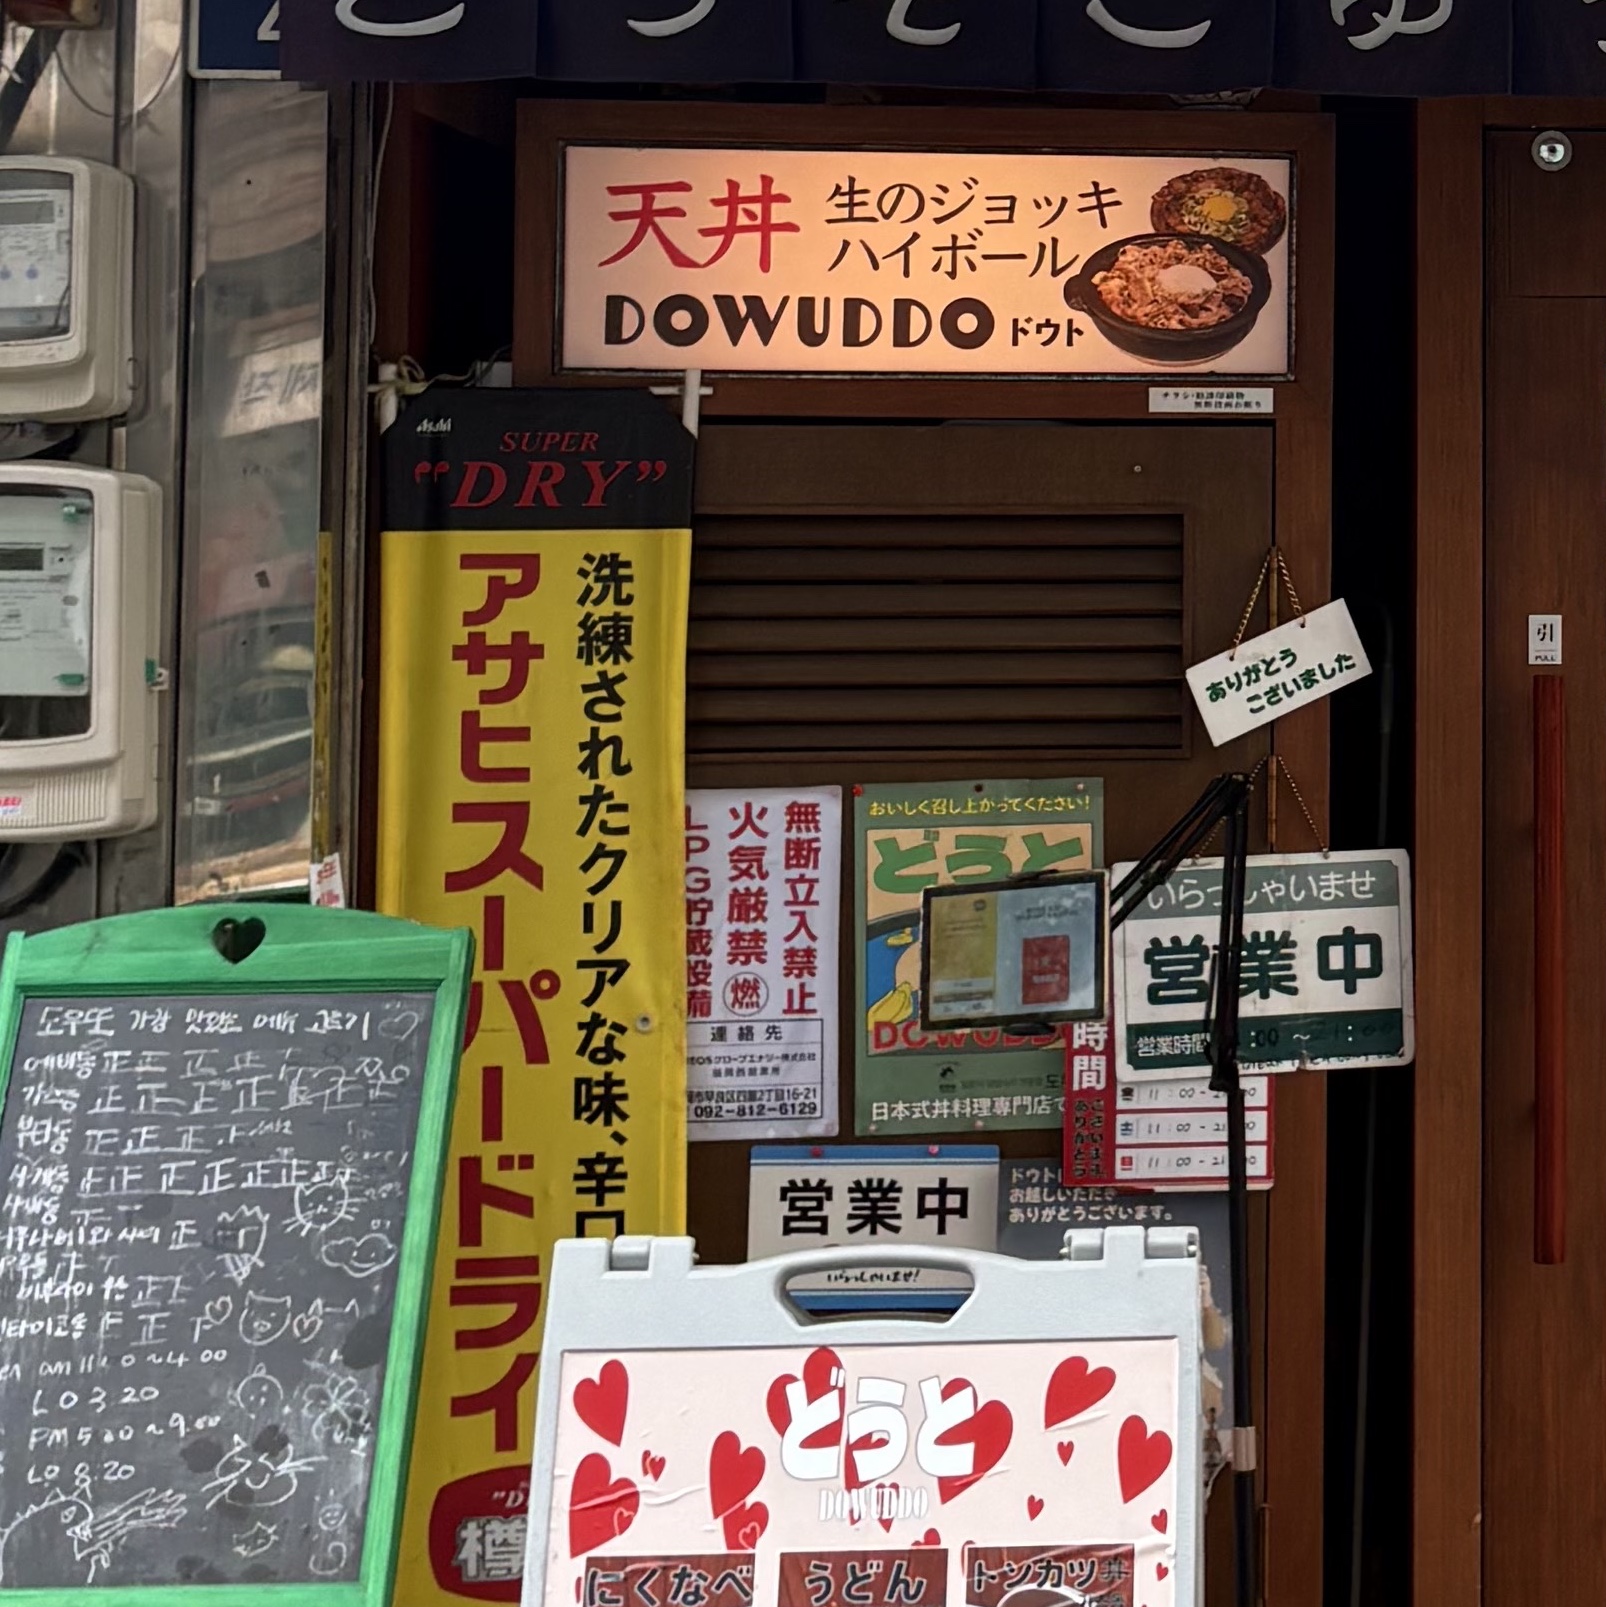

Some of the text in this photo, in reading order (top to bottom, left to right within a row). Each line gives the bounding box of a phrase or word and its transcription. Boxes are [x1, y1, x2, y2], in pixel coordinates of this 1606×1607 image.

[598, 174, 801, 274] 天丼
[826, 176, 1124, 229] 生のジョッキ
[828, 232, 1079, 281] ハイボール
[604, 294, 995, 350] DOWUDDO
[1010, 318, 1085, 348] ドウト
[499, 431, 600, 452] SUPER
[1537, 623, 1553, 642] 引
[1205, 648, 1298, 703] ありがとう
[726, 800, 769, 966] 火気厳禁
[782, 800, 821, 1016] 無断立入禁止
[1143, 926, 1384, 1006] 営業中
[444, 552, 562, 1454] アサヒスーパードライ
[731, 977, 761, 1010] 燃
[710, 1025, 783, 1043] 連絡先
[694, 1102, 817, 1118] 092-812-6129
[1010, 1168, 1062, 1183] ドウト
[779, 1177, 969, 1236] 営業中
[1009, 1206, 1172, 1223] ありがとうございます。
[29, 1427, 68, 1451] PM
[780, 1365, 979, 1483] どうと
[587, 1564, 752, 1607] にくなべ
[805, 1560, 927, 1605] うどん
[975, 1556, 1129, 1592] トンカツ丼
